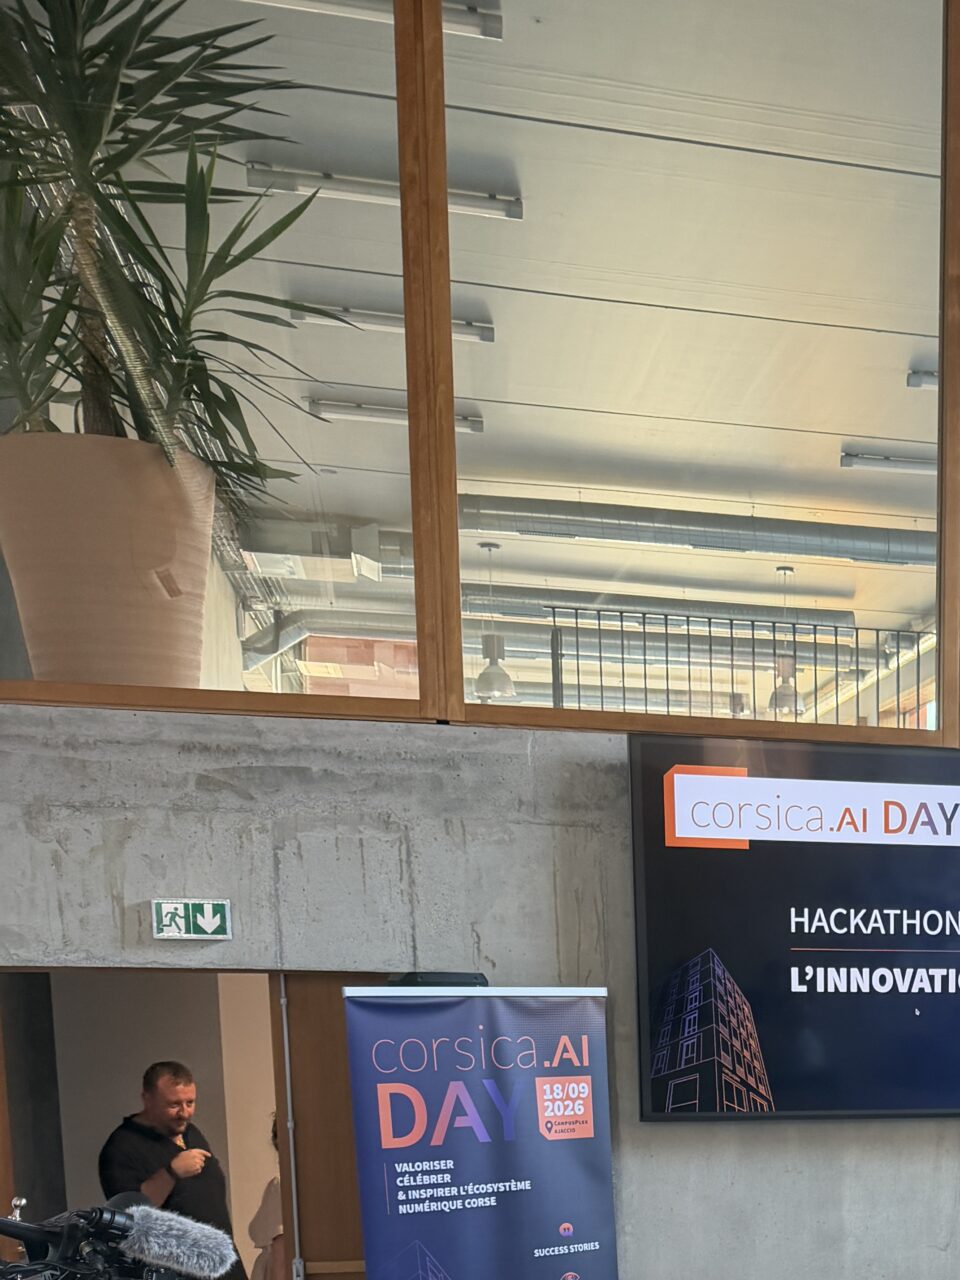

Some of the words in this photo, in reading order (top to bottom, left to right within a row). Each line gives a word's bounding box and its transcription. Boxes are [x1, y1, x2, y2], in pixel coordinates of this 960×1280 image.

[690, 794, 868, 833] corsica.AI
[883, 799, 960, 836] DAY
[372, 1024, 590, 1073] corsica.AI
[543, 1083, 589, 1100] 18/09
[377, 1079, 524, 1149] DAY
[544, 1100, 585, 1117] 2026
[395, 1159, 454, 1173] VALORISER
[396, 1173, 452, 1187] CÉLÉBRER
[397, 1191, 406, 1201] &
[408, 1187, 458, 1200] INSPIRER
[399, 1199, 463, 1214] NUMÉRIQUE
[465, 1197, 497, 1209] CORSE
[534, 1246, 568, 1257] SUCCESS
[570, 1241, 600, 1253] STORIES
